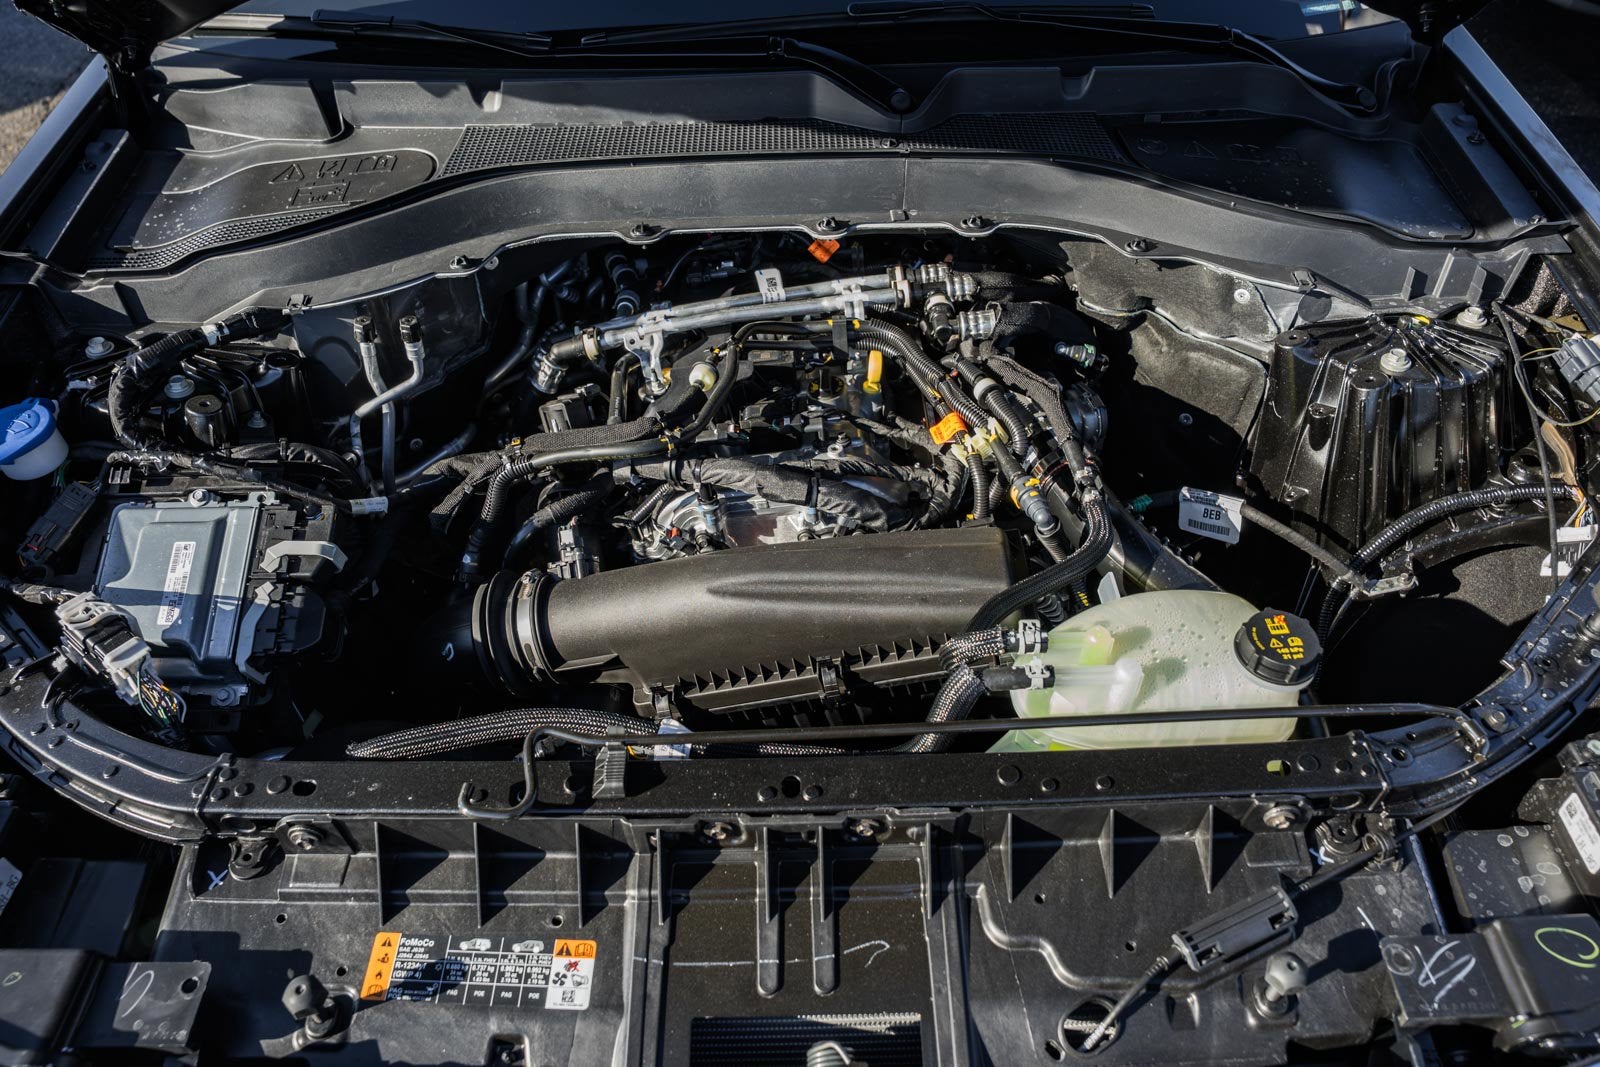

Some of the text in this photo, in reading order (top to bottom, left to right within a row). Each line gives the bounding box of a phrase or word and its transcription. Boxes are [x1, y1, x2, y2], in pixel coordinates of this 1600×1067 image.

[400, 938, 435, 947] FoMoCo
[395, 961, 427, 970] R-1234yf
[500, 991, 513, 999] PAG
